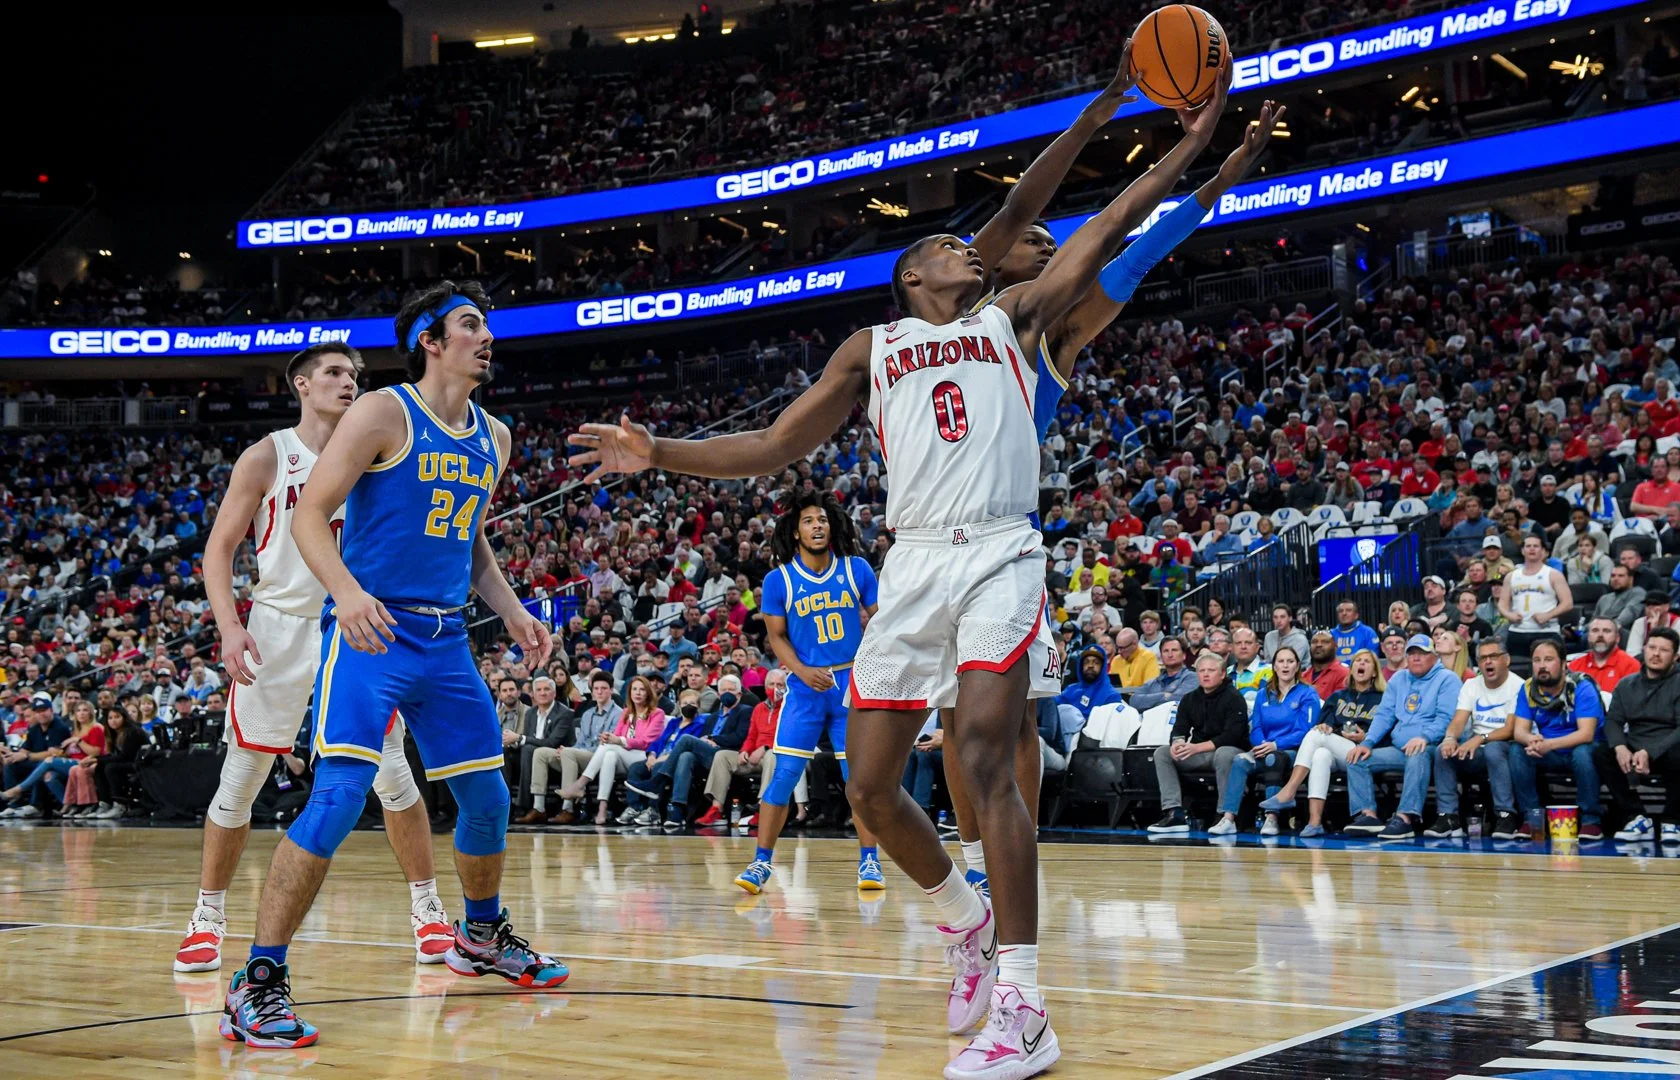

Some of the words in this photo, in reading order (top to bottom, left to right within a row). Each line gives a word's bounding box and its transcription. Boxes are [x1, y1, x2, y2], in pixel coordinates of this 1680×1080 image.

[1229, 42, 1334, 90] EICO
[1340, 26, 1434, 60] Bundling
[1441, 6, 1507, 37] Made
[1514, 0, 1572, 21] Easy
[716, 160, 815, 199] GEICO
[818, 150, 884, 177] Bundling
[888, 137, 935, 160] Made
[938, 128, 980, 149] Easy
[1219, 183, 1313, 215] Bundling
[1319, 167, 1383, 197] Made
[1390, 158, 1449, 184] Easy
[248, 217, 352, 245] GEICO
[356, 215, 427, 235] Bundling
[432, 212, 480, 230] Made
[484, 209, 524, 228] Easy
[1641, 211, 1680, 226] GEIC
[576, 291, 683, 327] GEICO
[686, 286, 753, 311] Bundling
[757, 276, 802, 299] Made
[805, 270, 846, 290] Easy
[49, 330, 170, 354] GEICO
[174, 331, 251, 351] Bundling
[256, 327, 304, 346] Made
[309, 326, 351, 344] Easy
[884, 336, 1003, 390] ARIZONA
[931, 380, 969, 443] 0
[418, 452, 495, 495] UCLA
[424, 488, 480, 541] 24
[794, 590, 855, 617] UCLA
[813, 612, 845, 644] 10
